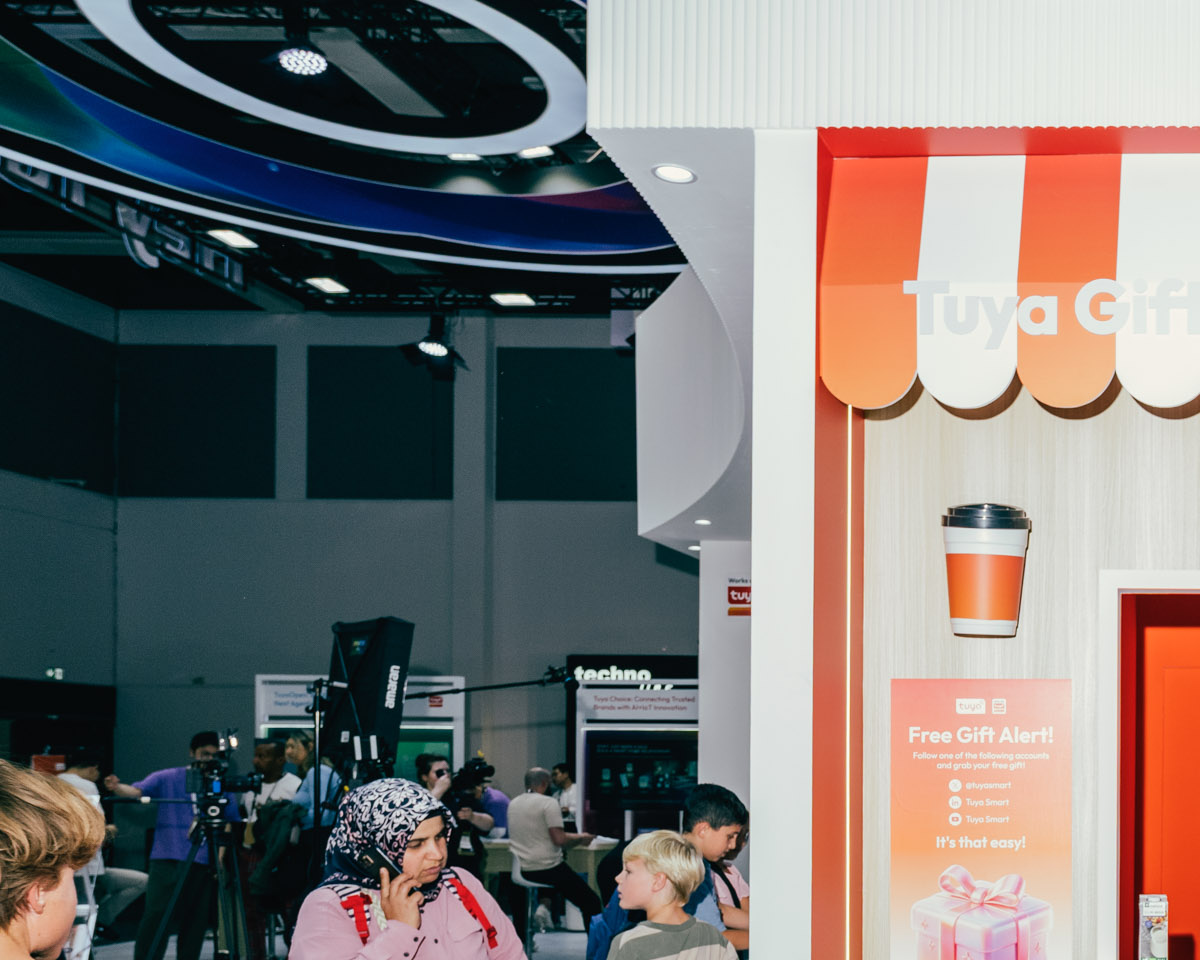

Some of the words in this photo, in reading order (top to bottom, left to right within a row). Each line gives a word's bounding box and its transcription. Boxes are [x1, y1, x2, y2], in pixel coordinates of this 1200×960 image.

[903, 279, 1057, 349] Tuya
[730, 590, 751, 603] tuy
[573, 665, 651, 680] techno
[384, 664, 401, 709] amaran
[959, 703, 981, 712] tuya
[908, 726, 953, 744] Free
[957, 726, 995, 744] Gift
[999, 726, 1054, 744] Alert!
[912, 752, 937, 760] Follow
[955, 752, 964, 760] of
[965, 752, 978, 760] the
[979, 752, 1013, 761] following
[1015, 752, 1050, 760] accounts
[936, 761, 951, 769] and
[953, 761, 972, 771] grab
[973, 763, 990, 771] your
[991, 761, 1008, 769] free
[1009, 761, 1026, 771] gift!
[965, 781, 1011, 790] @tuyasmart
[966, 799, 984, 807] Tuya
[985, 798, 1009, 806] Smart
[966, 816, 984, 824] Tuya
[985, 815, 1009, 823] Smart
[936, 836, 956, 849] It's
[958, 836, 988, 849] that
[990, 836, 1026, 851] easy!
